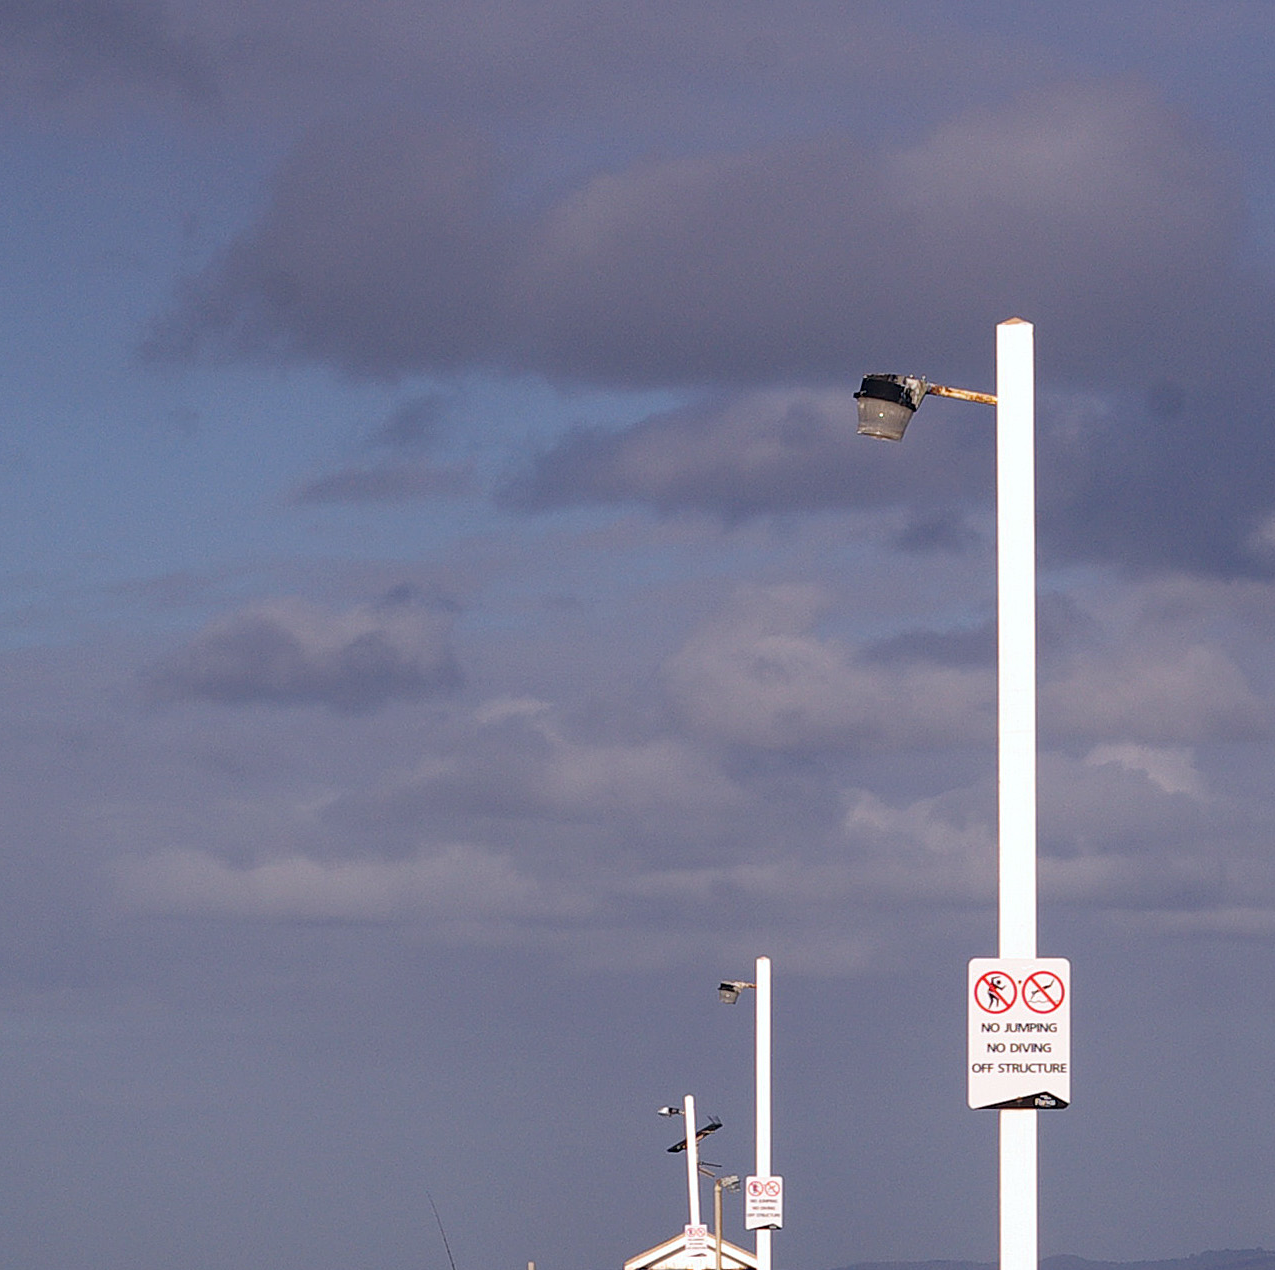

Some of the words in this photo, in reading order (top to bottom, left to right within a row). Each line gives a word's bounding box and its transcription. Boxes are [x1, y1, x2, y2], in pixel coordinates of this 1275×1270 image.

[981, 1023, 1000, 1032] NO
[1004, 1023, 1057, 1032] JUMPING
[987, 1043, 1006, 1053] NO
[1010, 1043, 1052, 1053] DIVING
[971, 1063, 994, 1073] OFF
[998, 1063, 1067, 1073] STRUCTURE
